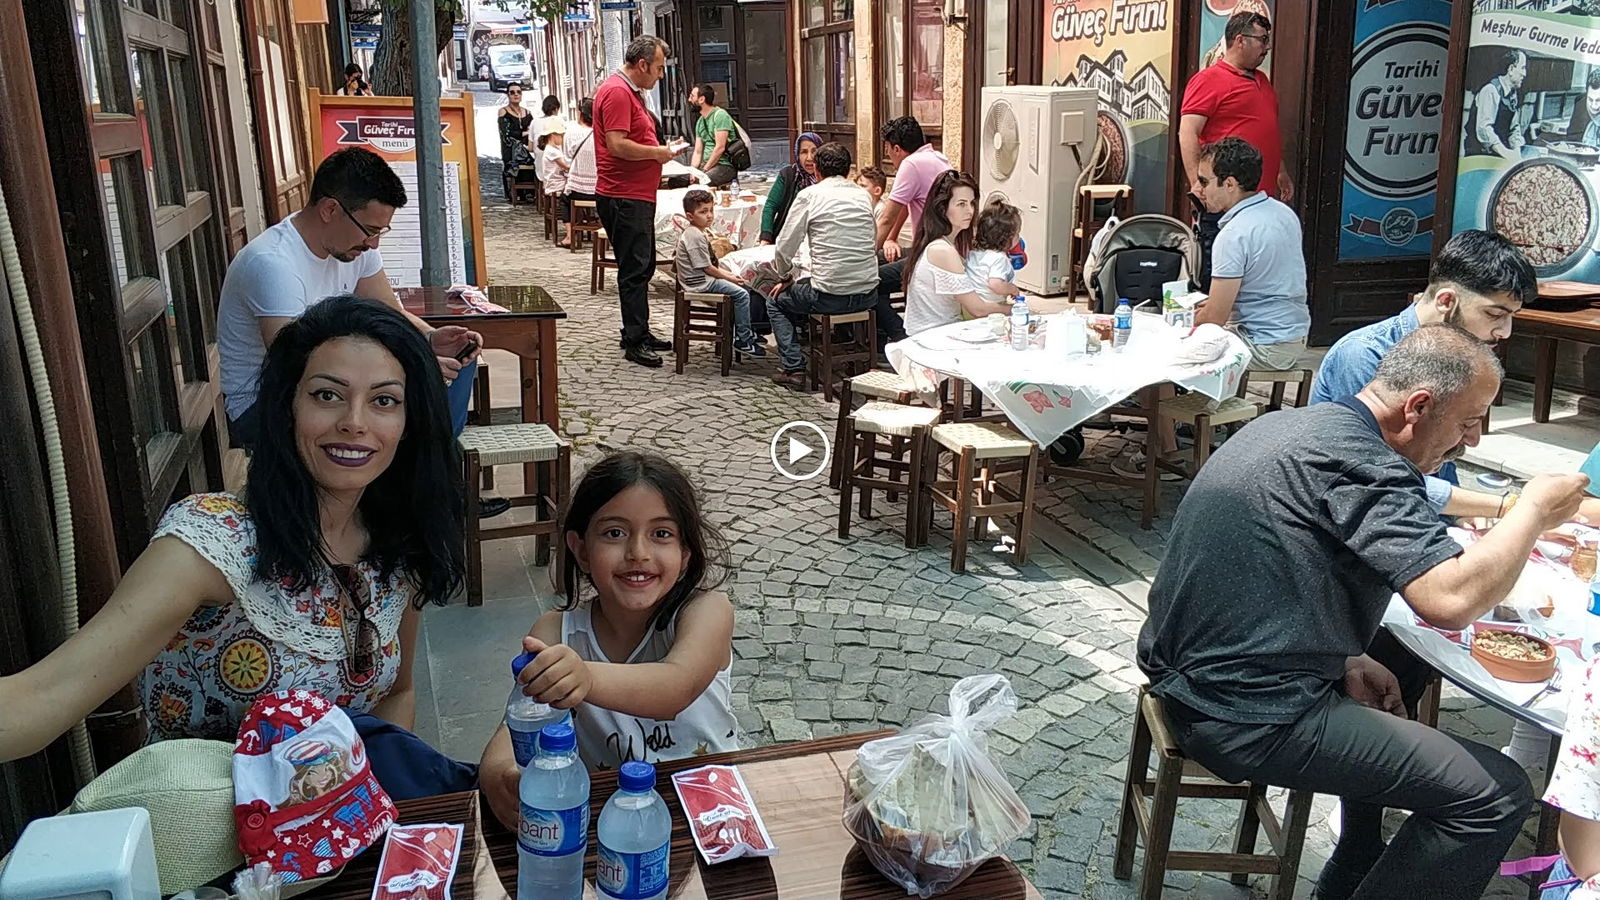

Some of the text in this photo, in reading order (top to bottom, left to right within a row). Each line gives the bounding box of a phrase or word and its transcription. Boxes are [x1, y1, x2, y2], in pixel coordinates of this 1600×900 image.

[1051, 0, 1168, 47] Güveç Fırını
[1481, 18, 1526, 38] Meşhur
[1529, 26, 1569, 49] Gurme
[1384, 60, 1440, 79] Tarihi
[1355, 84, 1444, 120] Güve
[363, 124, 416, 138] Güveç Fırı
[382, 140, 409, 148] menü
[1362, 126, 1440, 157] Fırın
[519, 817, 559, 840] bant
